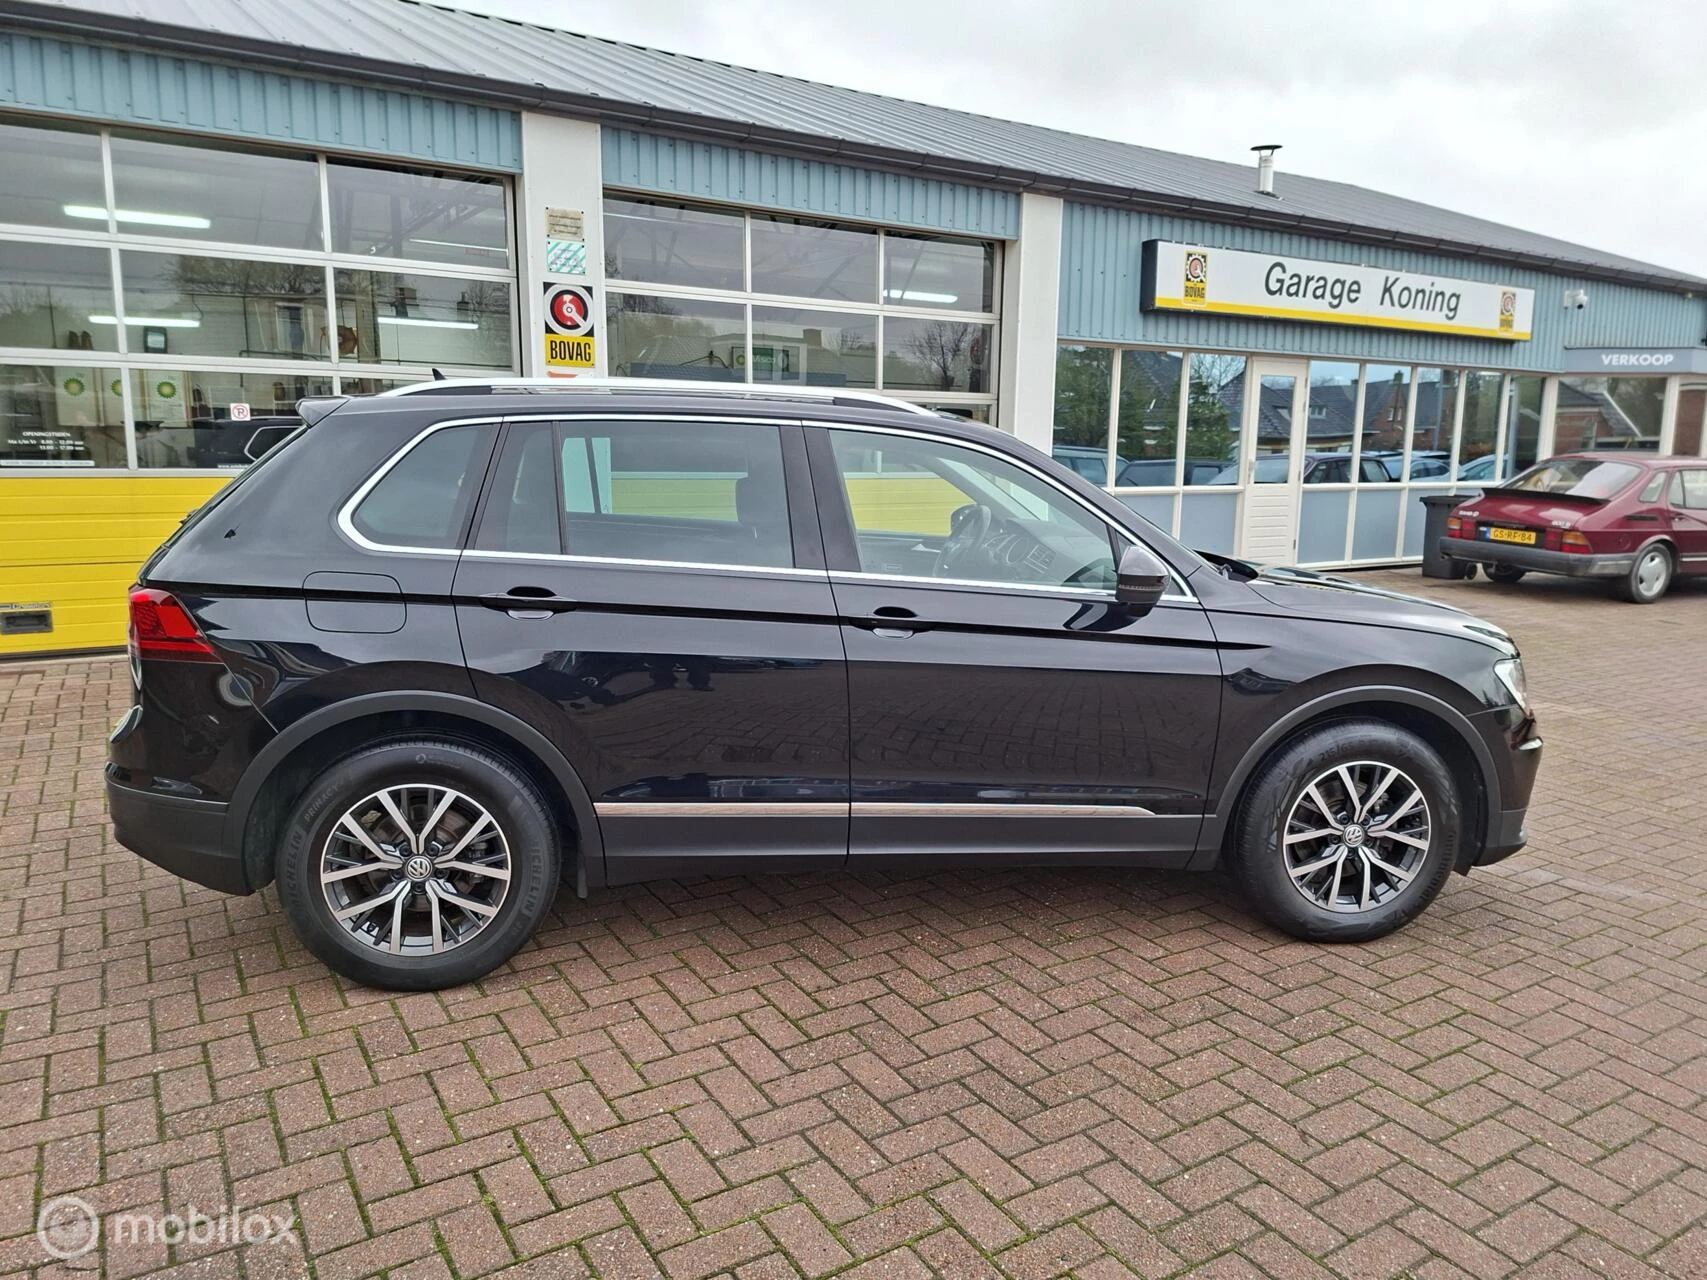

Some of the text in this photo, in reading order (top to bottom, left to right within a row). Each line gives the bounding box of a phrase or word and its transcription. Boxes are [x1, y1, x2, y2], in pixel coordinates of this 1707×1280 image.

[1185, 285, 1205, 298] BOVAG
[1264, 261, 1461, 321] Garage Koning
[549, 339, 592, 362] BOVAG
[1601, 353, 1674, 366] VERKOOP
